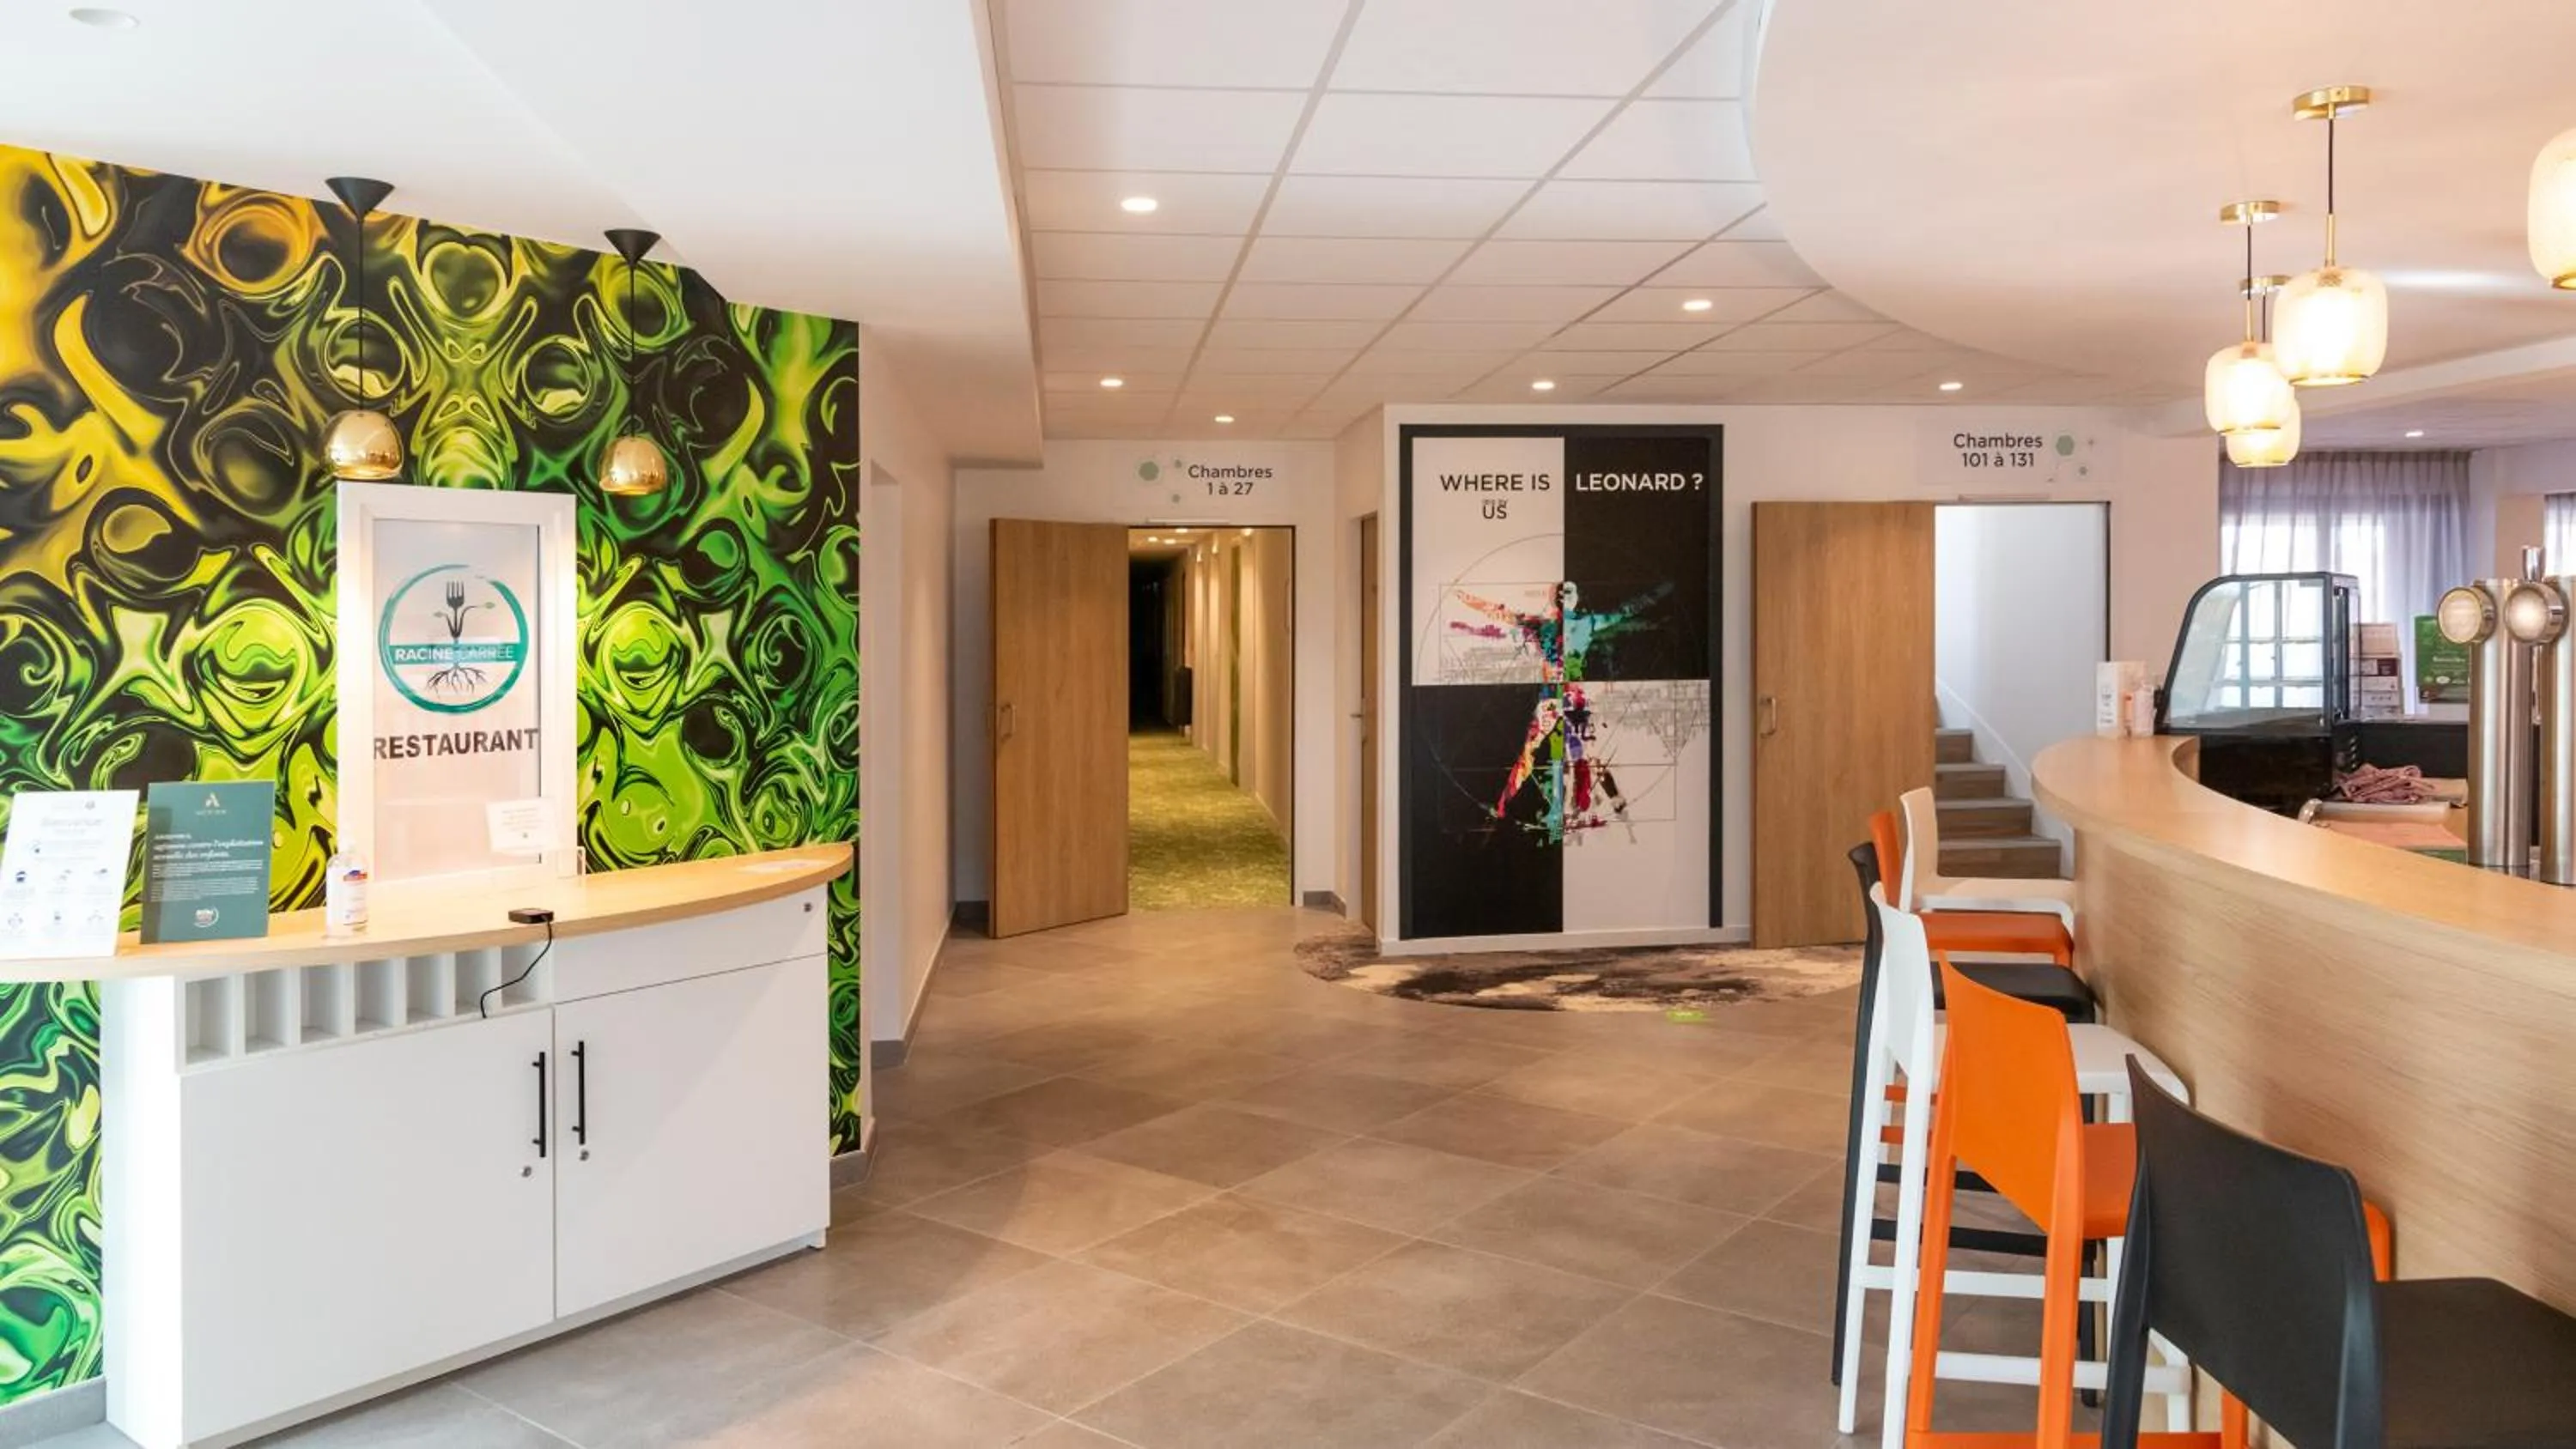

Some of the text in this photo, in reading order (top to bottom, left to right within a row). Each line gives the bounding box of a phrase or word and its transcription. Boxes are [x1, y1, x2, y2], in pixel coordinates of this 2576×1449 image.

[1953, 433, 2044, 448] Chambres
[1961, 452, 2035, 468] 101 à 131
[1188, 464, 1273, 479] Chambres
[1206, 482, 1255, 495] 1 à 27
[1439, 473, 1704, 492] WHERE IS LEONARD ?
[394, 646, 454, 662] RACINE
[374, 727, 539, 761] RESTAURANT
